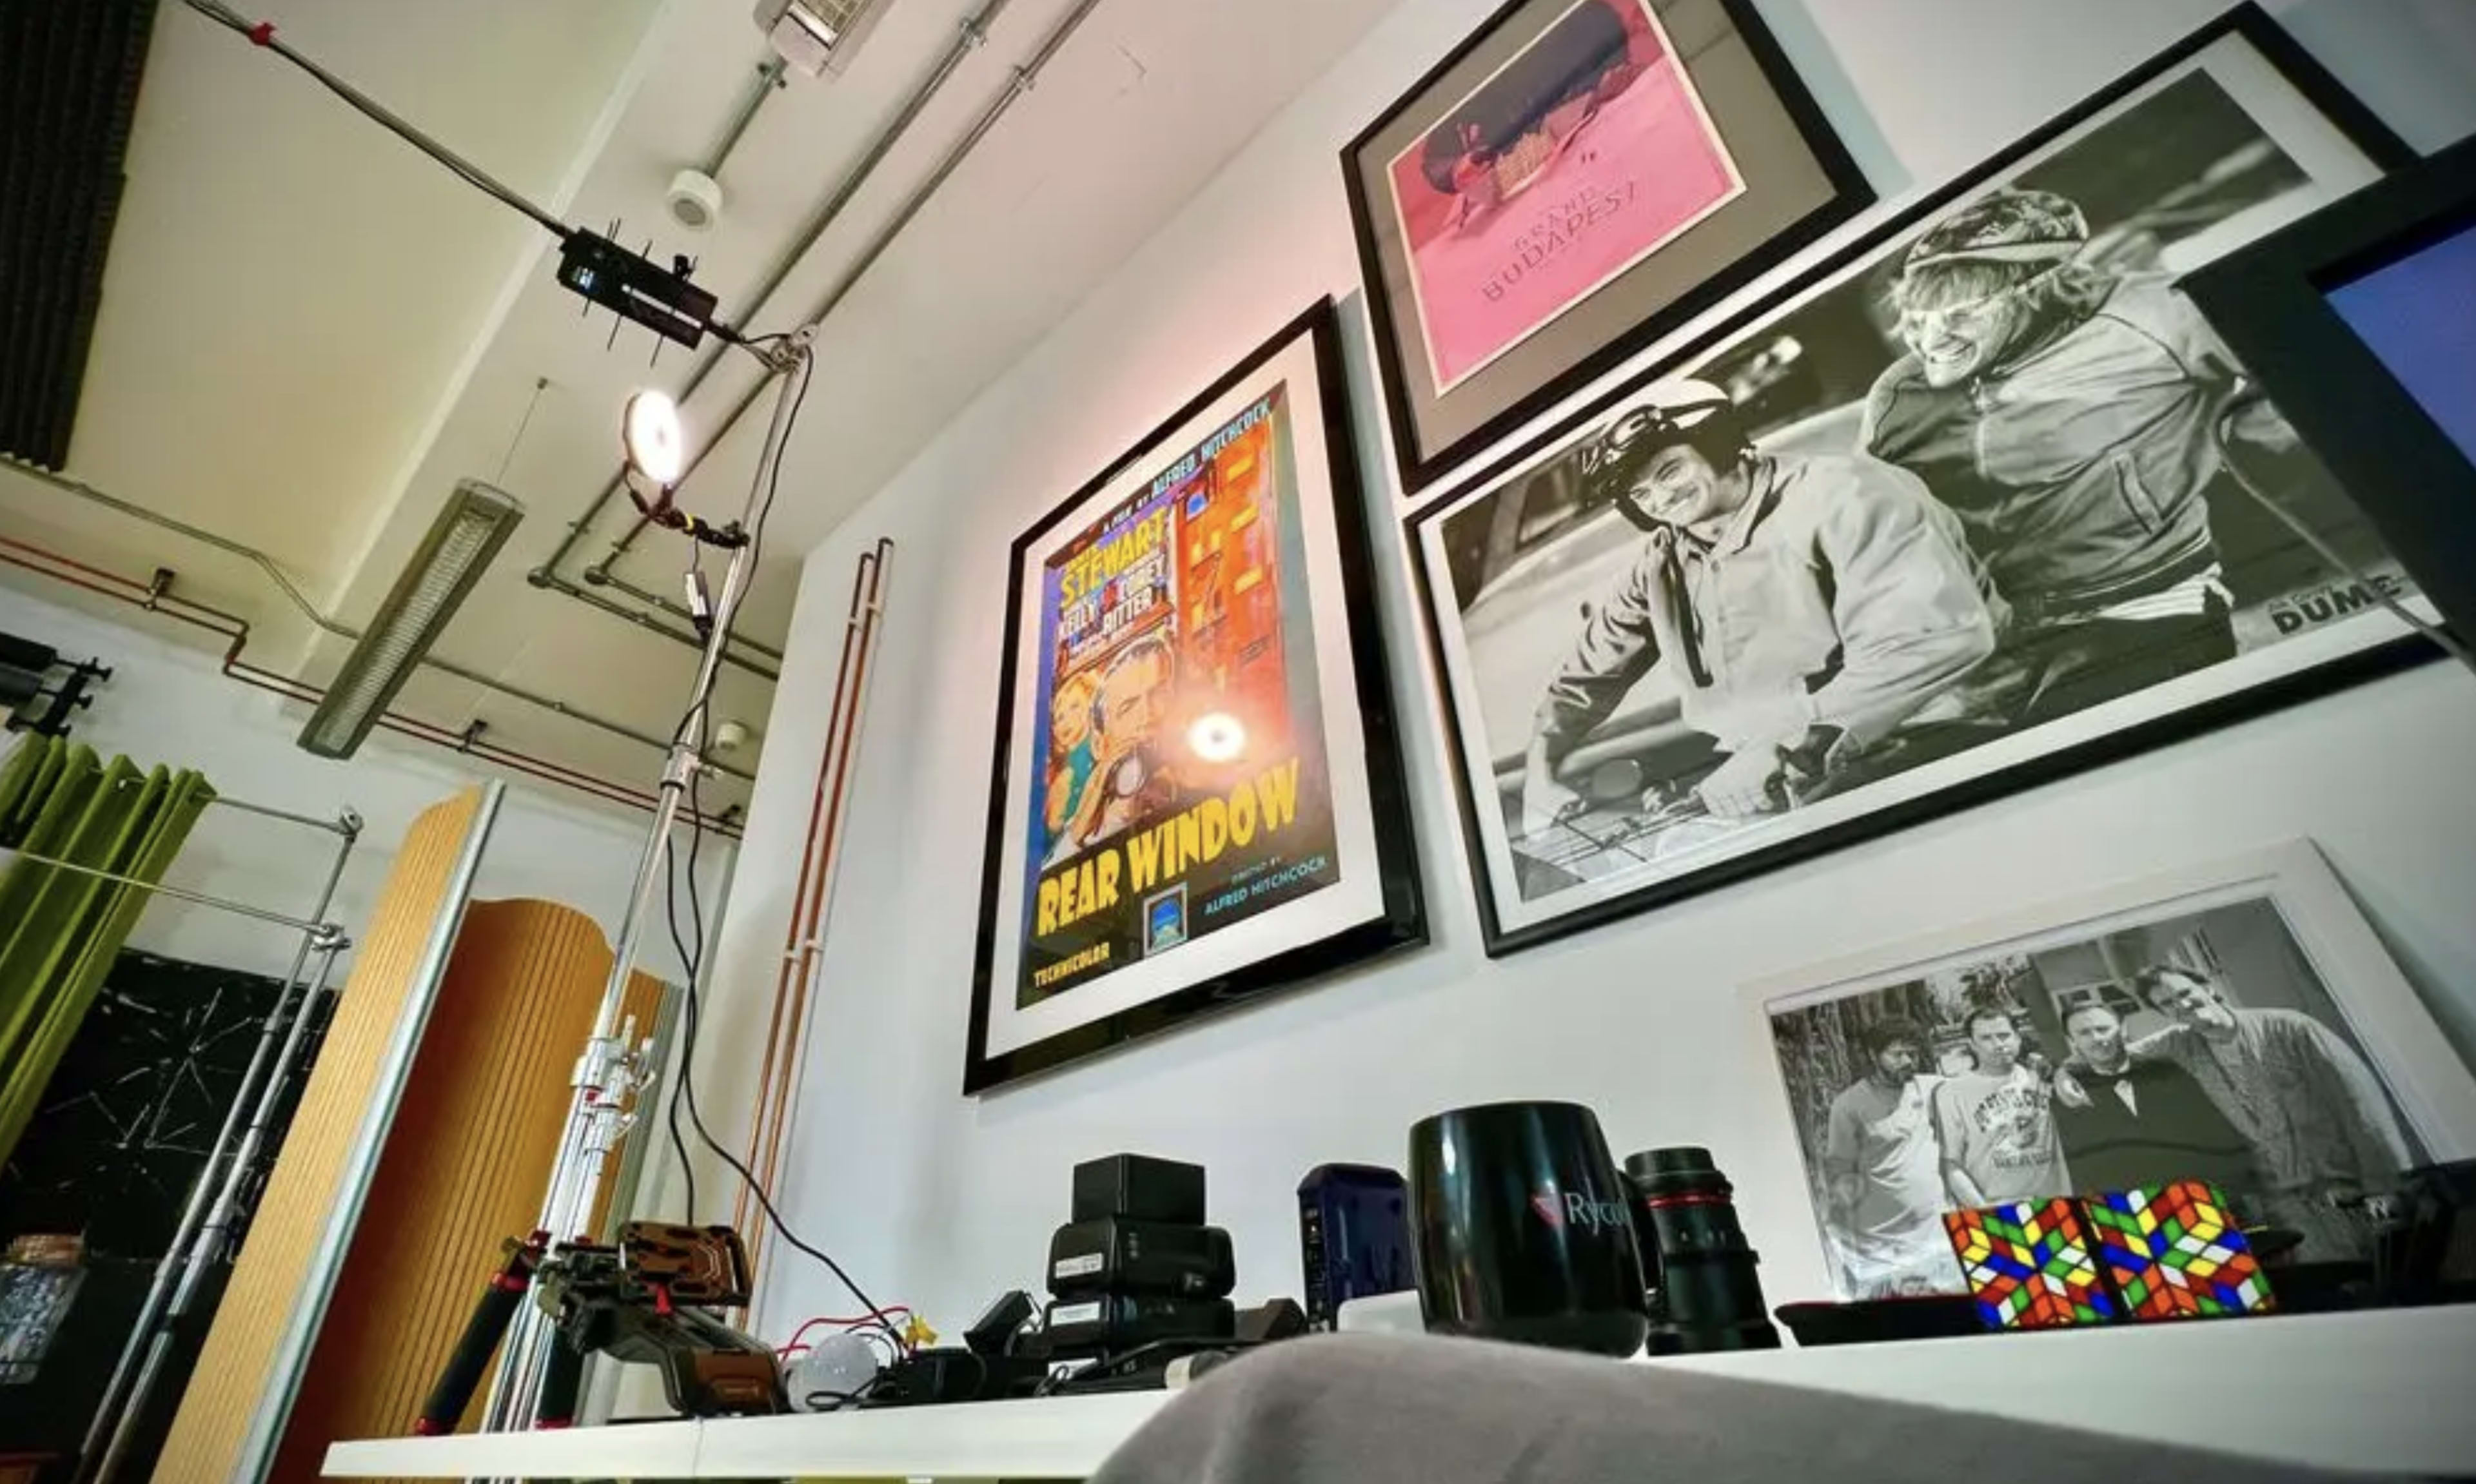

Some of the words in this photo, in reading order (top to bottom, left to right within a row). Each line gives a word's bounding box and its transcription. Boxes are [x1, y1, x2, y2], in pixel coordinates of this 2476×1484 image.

[1152, 454, 1194, 498] ALFRED
[1201, 396, 1270, 462] HITCHCOCK
[1061, 507, 1167, 610] STEWART
[1038, 849, 1120, 936] REAR
[1126, 757, 1299, 893] WINDOW
[1204, 886, 1248, 915] ALFRED
[1251, 855, 1327, 895] HITCHCOCK
[1034, 942, 1110, 988] TECHNICOLOR
